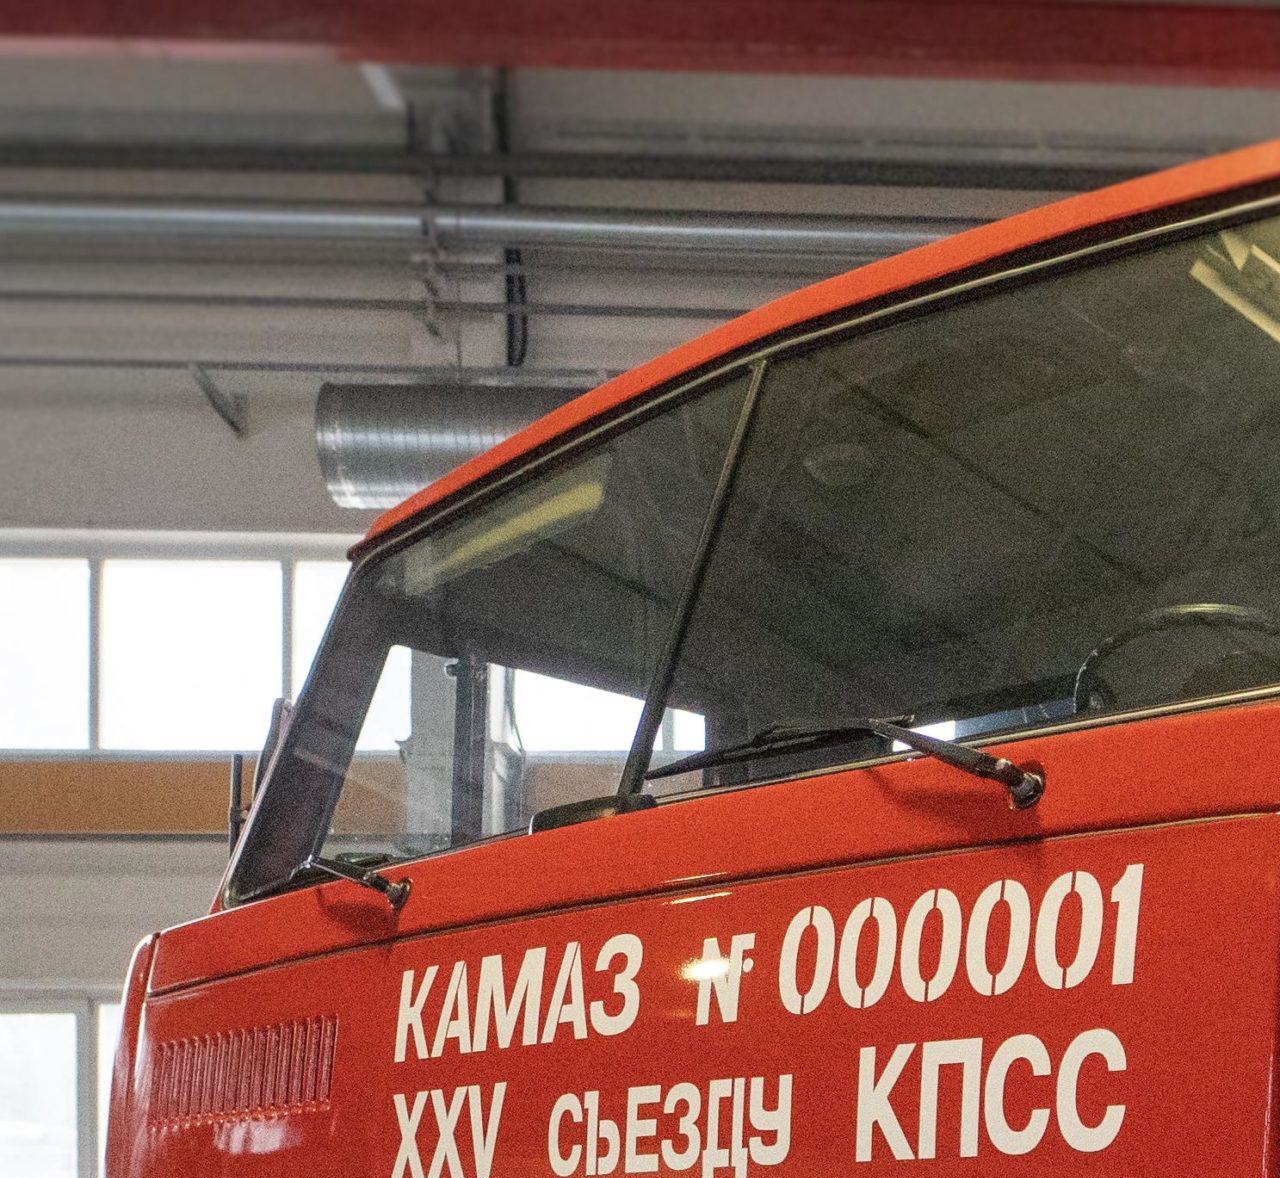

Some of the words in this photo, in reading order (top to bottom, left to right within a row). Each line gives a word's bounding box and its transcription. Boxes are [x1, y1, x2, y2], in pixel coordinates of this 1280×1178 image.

[394, 933, 644, 1062] КАМАЗ
[779, 864, 1145, 1015] 000001
[856, 1028, 1127, 1163] КПСС
